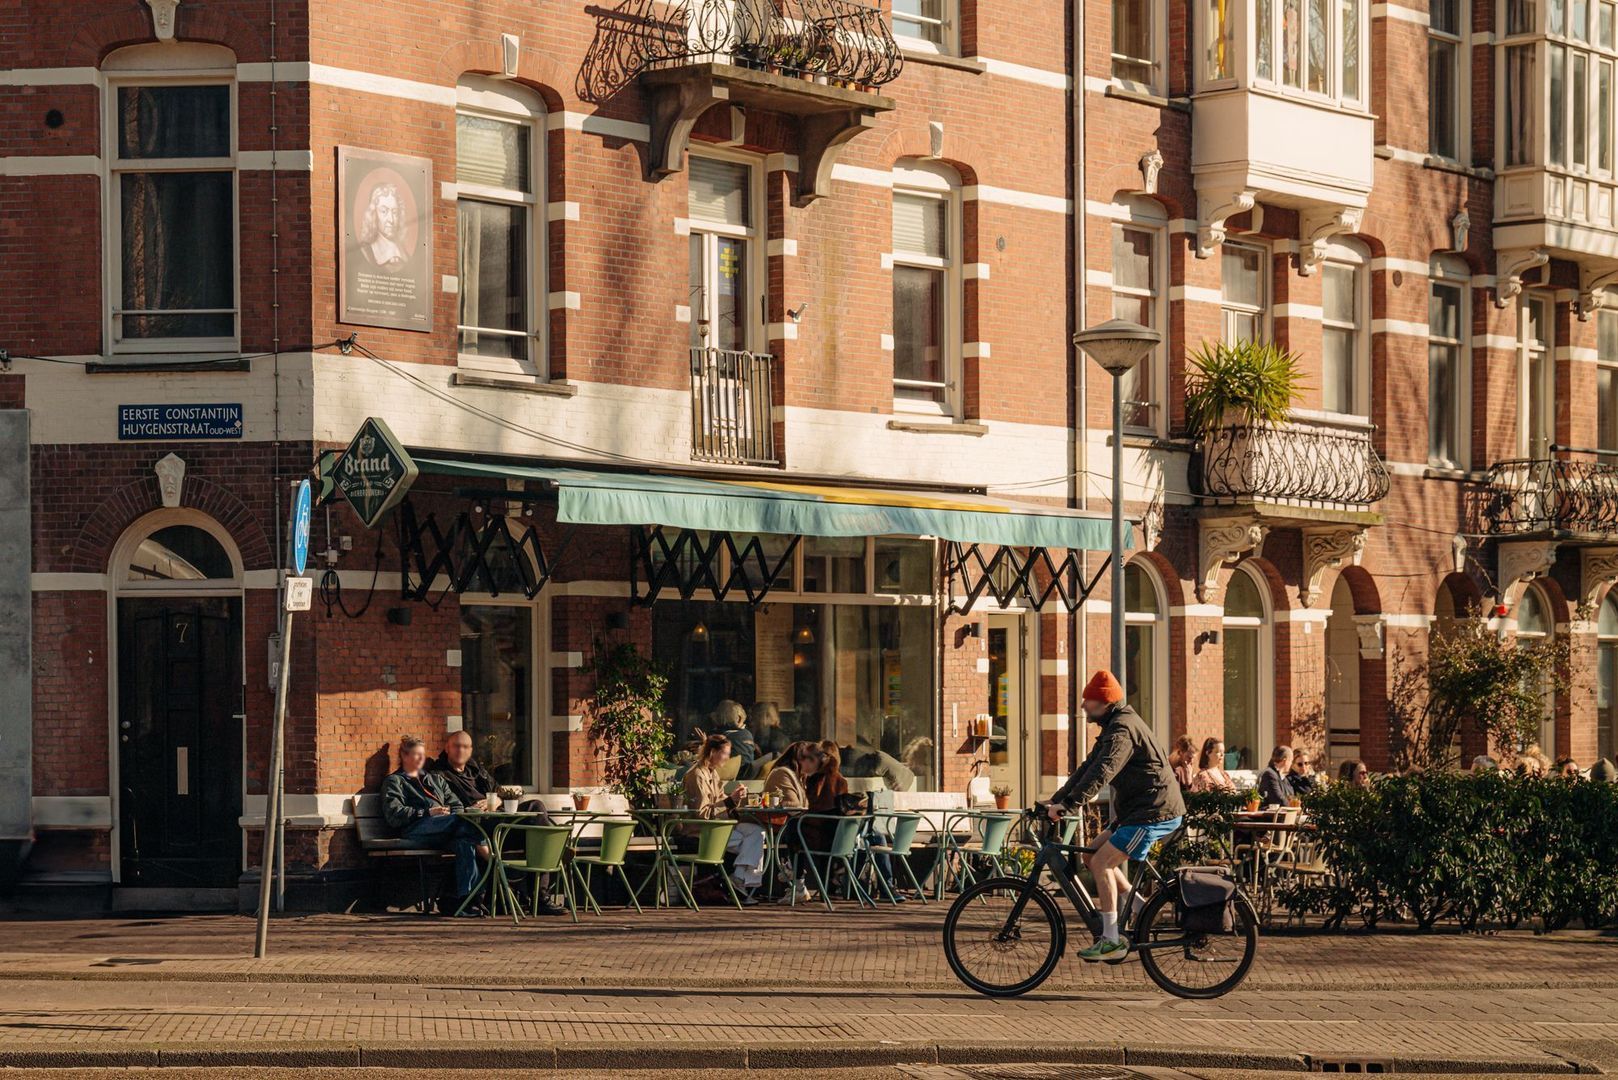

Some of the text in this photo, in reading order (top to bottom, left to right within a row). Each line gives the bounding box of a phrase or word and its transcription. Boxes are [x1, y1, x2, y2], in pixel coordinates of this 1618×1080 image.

[122, 407, 239, 422] EERSTE CONSTANTIJN
[122, 423, 242, 435] HUYGENSSTRAAT OUD-WEST
[344, 453, 390, 476] Brand
[175, 622, 188, 643] 7
